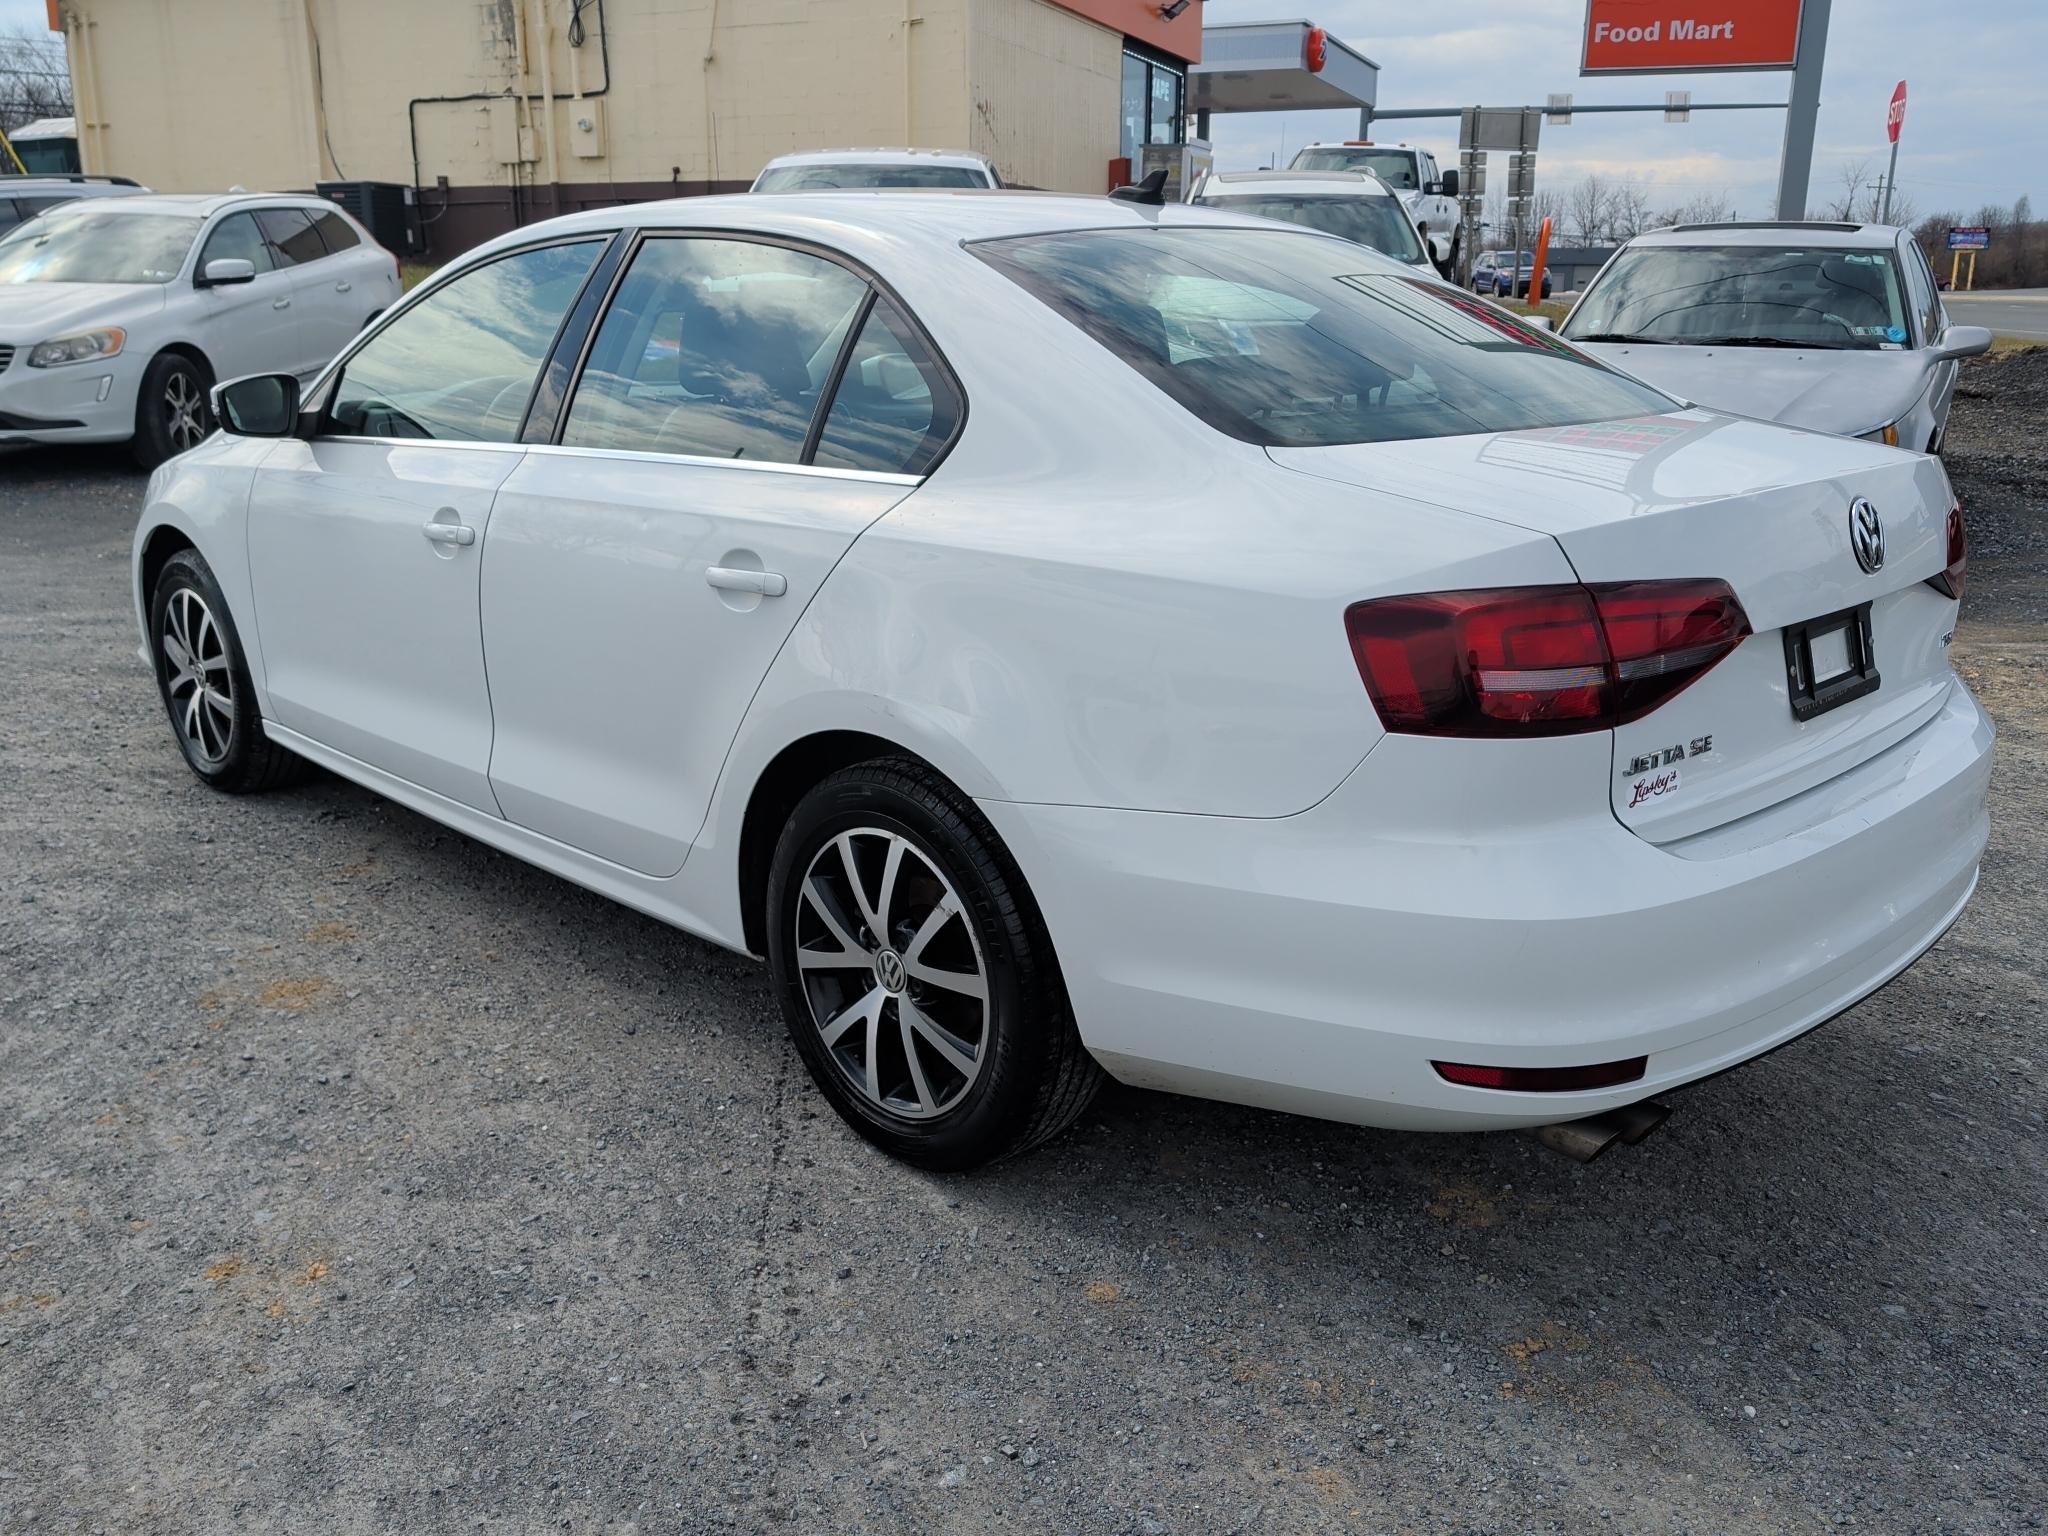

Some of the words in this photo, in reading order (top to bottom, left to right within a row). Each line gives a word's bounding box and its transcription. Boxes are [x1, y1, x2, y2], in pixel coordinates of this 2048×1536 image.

[1594, 21, 1661, 43] Food
[1668, 19, 1735, 41] Mart
[1889, 98, 1906, 125] STOP
[1622, 744, 1686, 777] JETTA
[1689, 734, 1713, 757] SE
